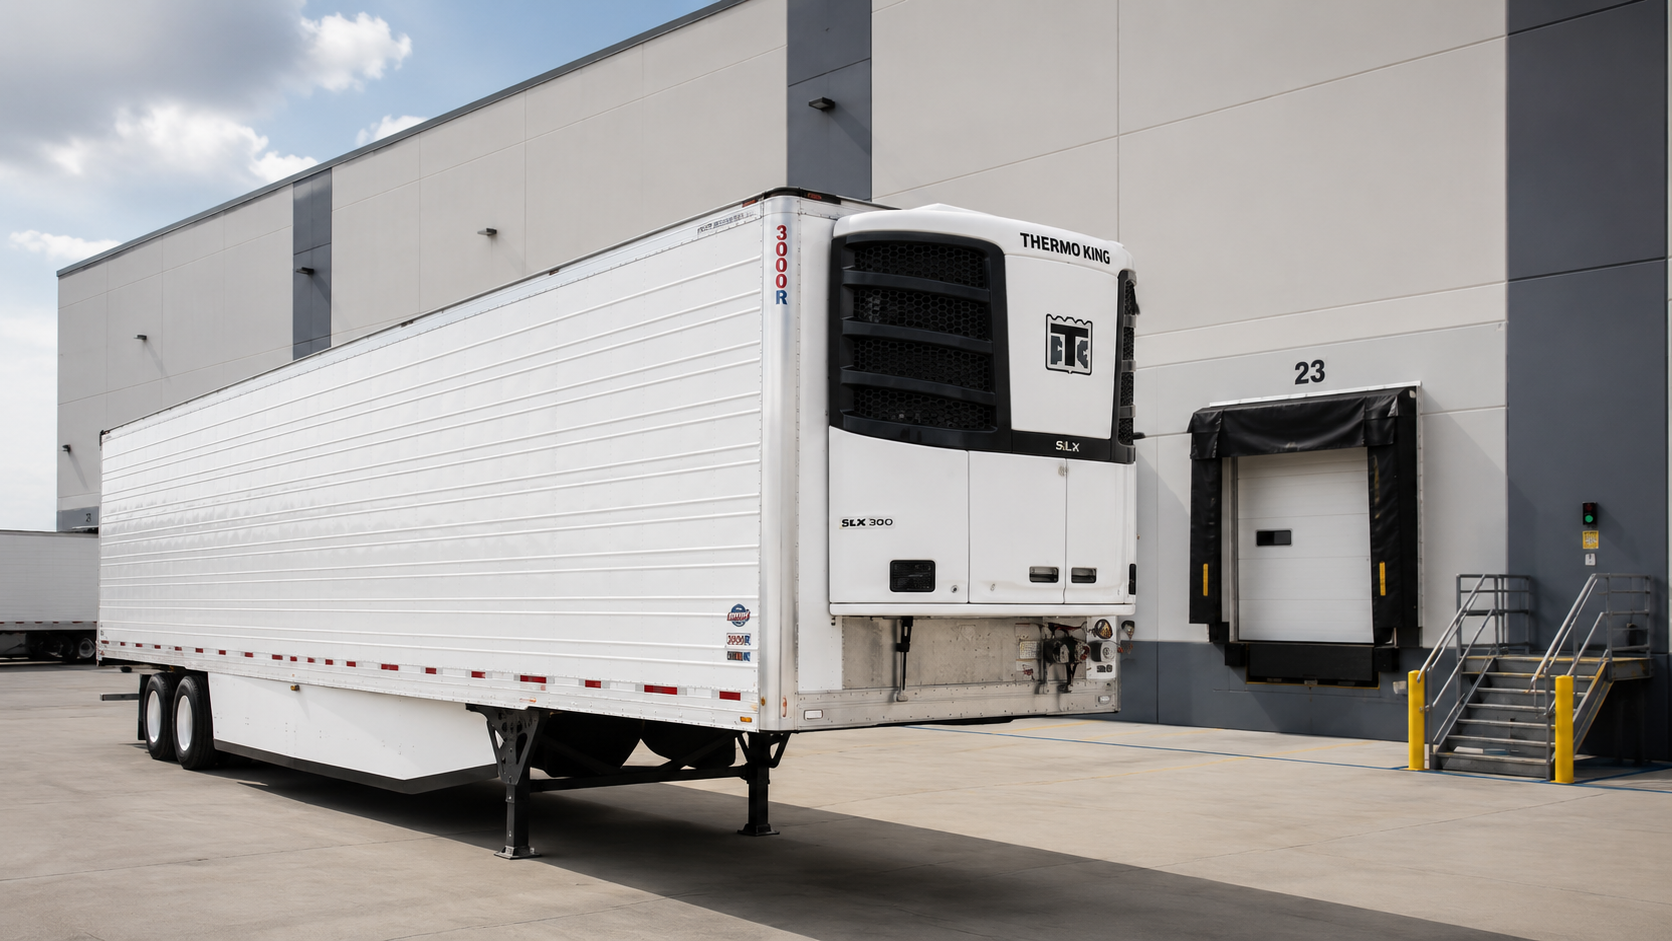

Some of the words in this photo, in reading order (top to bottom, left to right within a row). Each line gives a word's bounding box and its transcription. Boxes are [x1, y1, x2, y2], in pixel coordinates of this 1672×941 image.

[1020, 232, 1080, 257] THERMO
[1083, 245, 1110, 265] KING
[775, 224, 788, 305] 3000R
[1295, 359, 1326, 385] 23
[1055, 440, 1080, 452] SLX
[841, 518, 866, 527] SLX
[869, 518, 894, 526] 300
